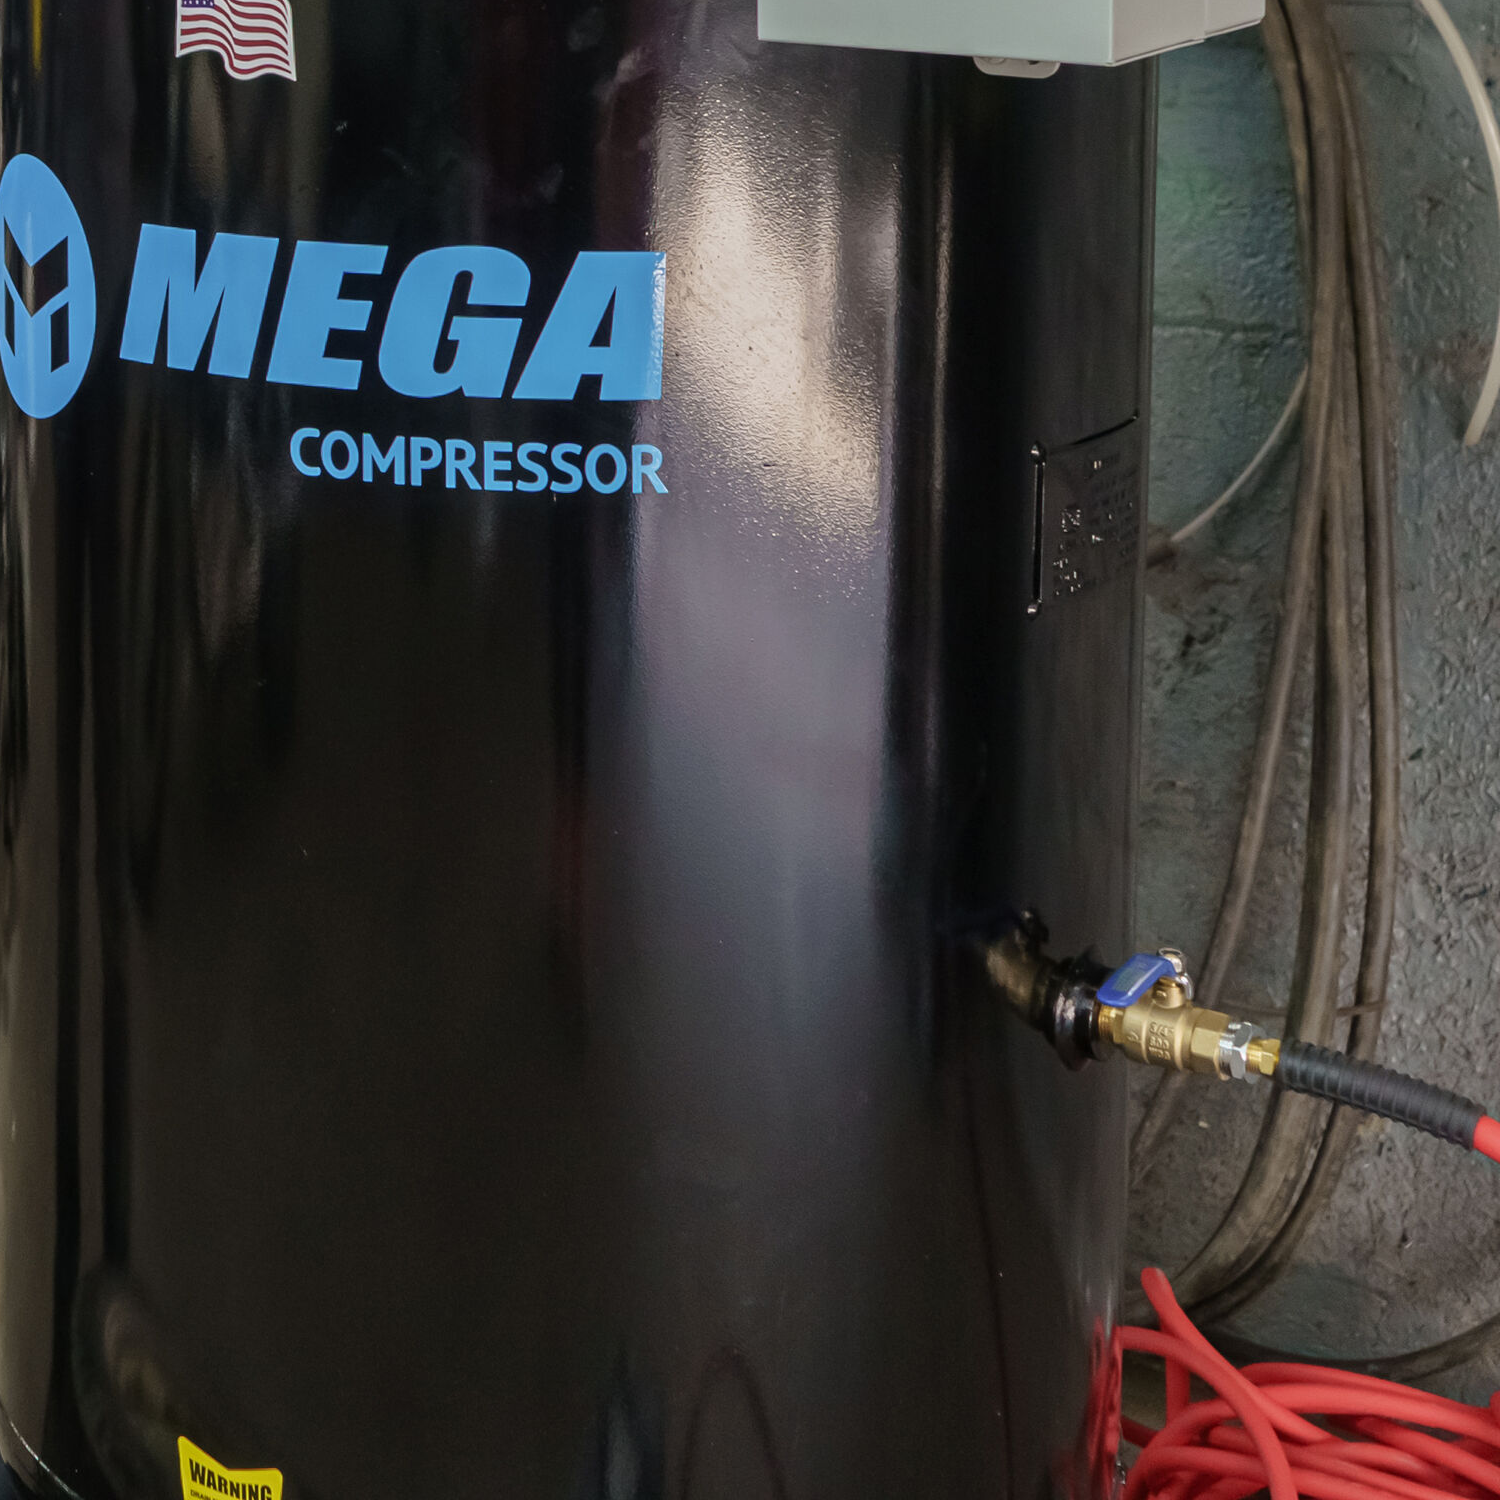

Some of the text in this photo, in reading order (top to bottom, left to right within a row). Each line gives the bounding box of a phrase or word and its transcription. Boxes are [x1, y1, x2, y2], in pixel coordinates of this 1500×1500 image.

[119, 222, 667, 401] MEGA
[289, 427, 669, 494] COMPRESSOR
[189, 1458, 272, 1500] WARNING
